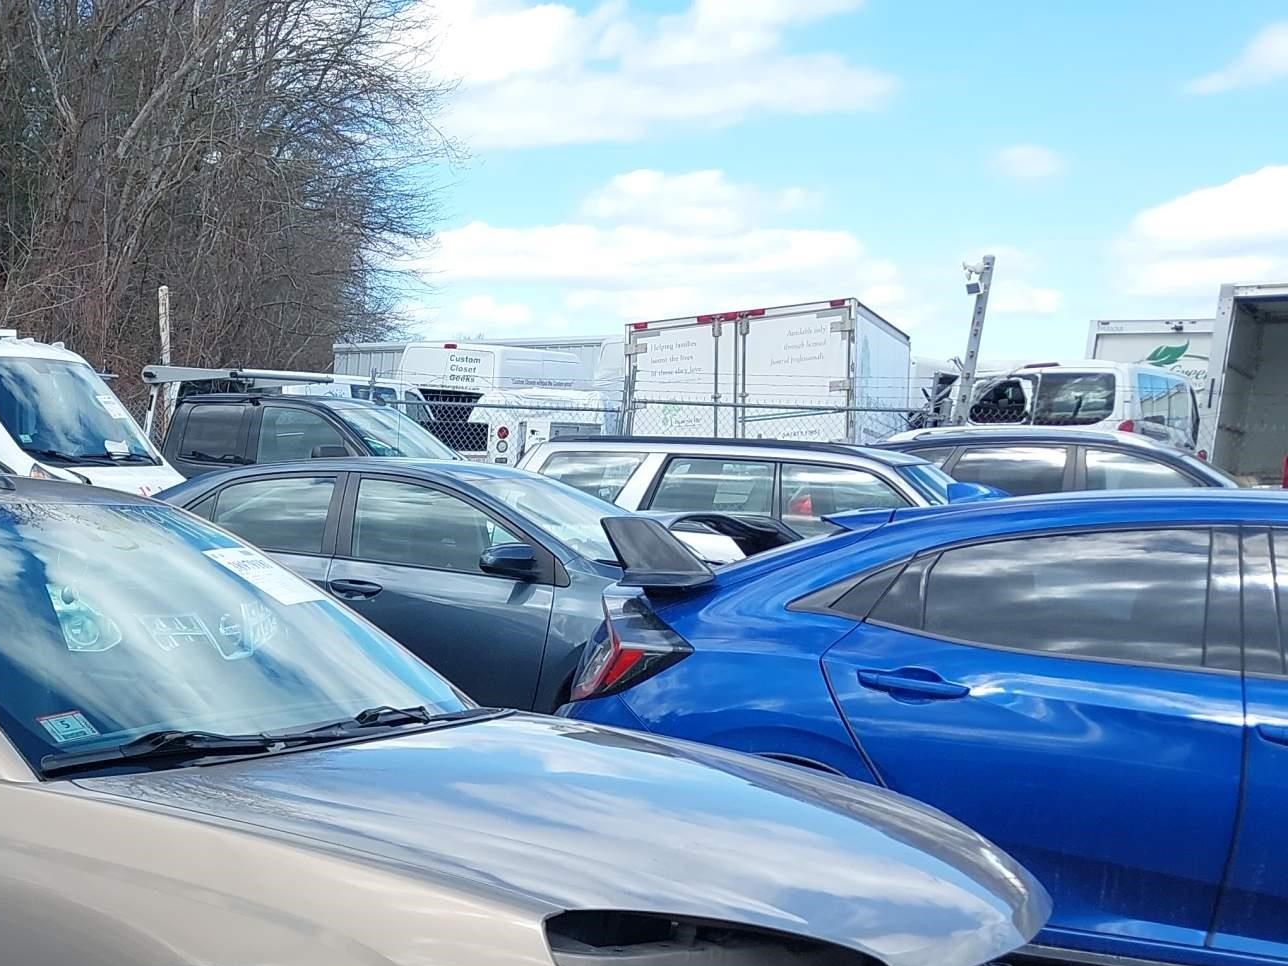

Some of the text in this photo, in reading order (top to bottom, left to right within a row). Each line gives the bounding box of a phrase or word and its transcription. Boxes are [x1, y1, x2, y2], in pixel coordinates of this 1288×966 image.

[449, 354, 481, 364] Custom
[450, 364, 477, 373] Closet
[449, 374, 474, 383] Geeks
